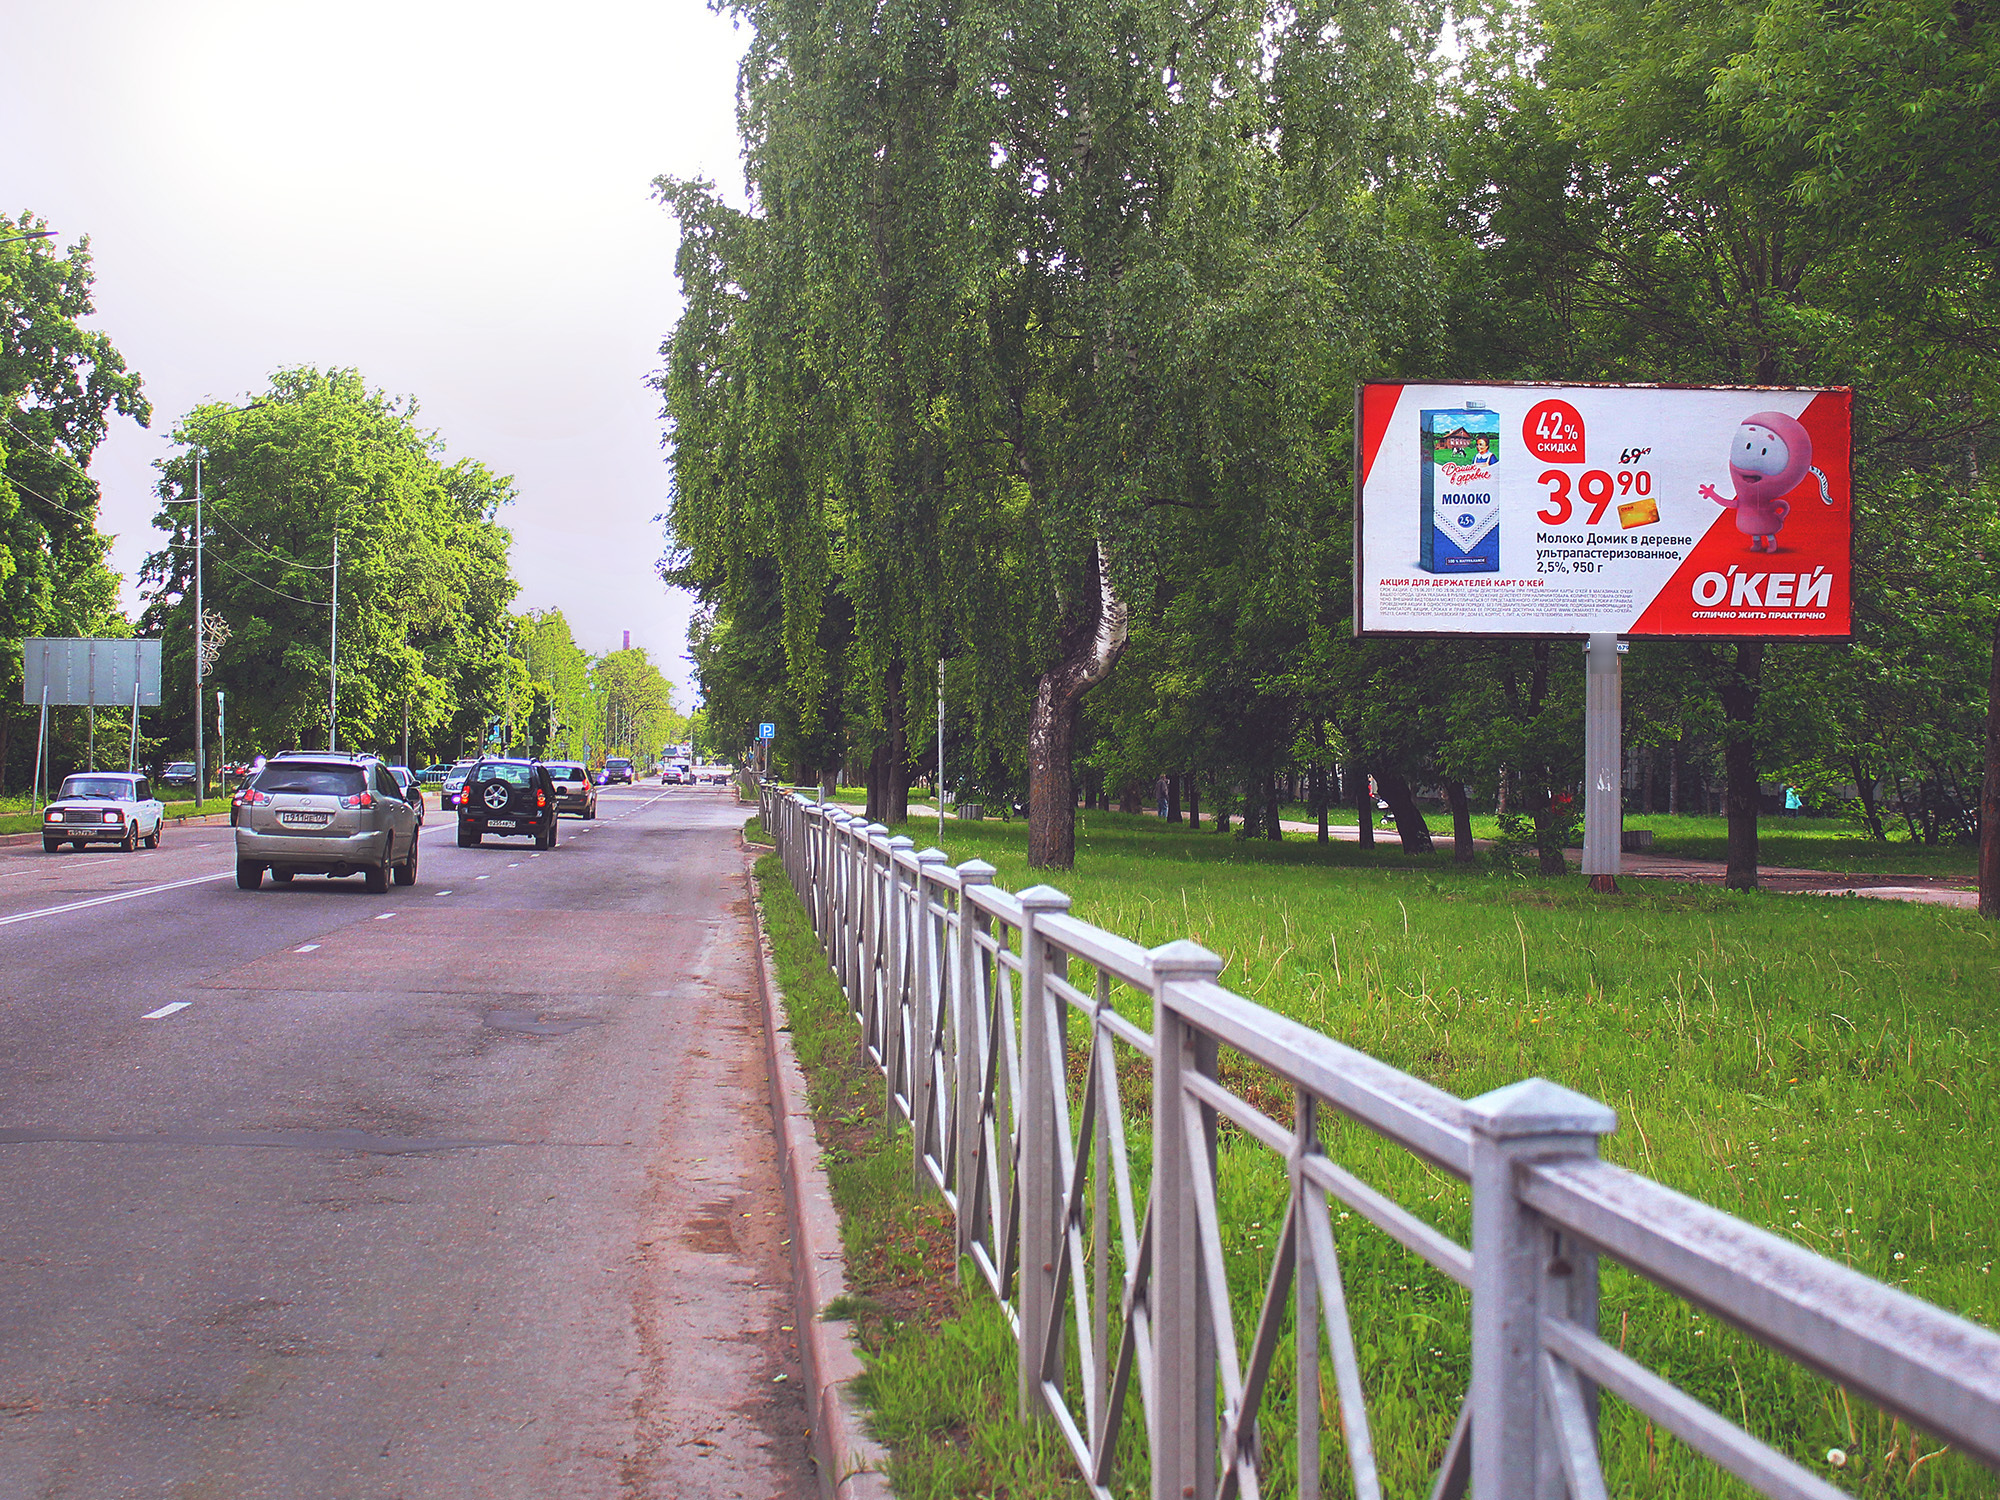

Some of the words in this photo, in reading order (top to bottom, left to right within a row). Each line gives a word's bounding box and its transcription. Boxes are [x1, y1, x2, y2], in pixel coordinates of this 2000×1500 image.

[1536, 412, 1578, 441] 42%
[1538, 443, 1577, 453] СКИДКА
[1442, 462, 1477, 477] Домик
[1457, 469, 1491, 486] деревне
[1442, 494, 1490, 504] МОЛОКО
[1537, 470, 1614, 525] 39
[1618, 471, 1651, 495] 90
[1537, 533, 1583, 543] Молоко
[1587, 533, 1627, 545] Домик
[1631, 536, 1637, 544] в
[1641, 536, 1691, 547] деревне
[1536, 548, 1681, 562] ультрапастеризованное,
[1537, 562, 1569, 574] 2,5%,
[1573, 562, 1594, 572] 950
[763, 726, 772, 736] P
